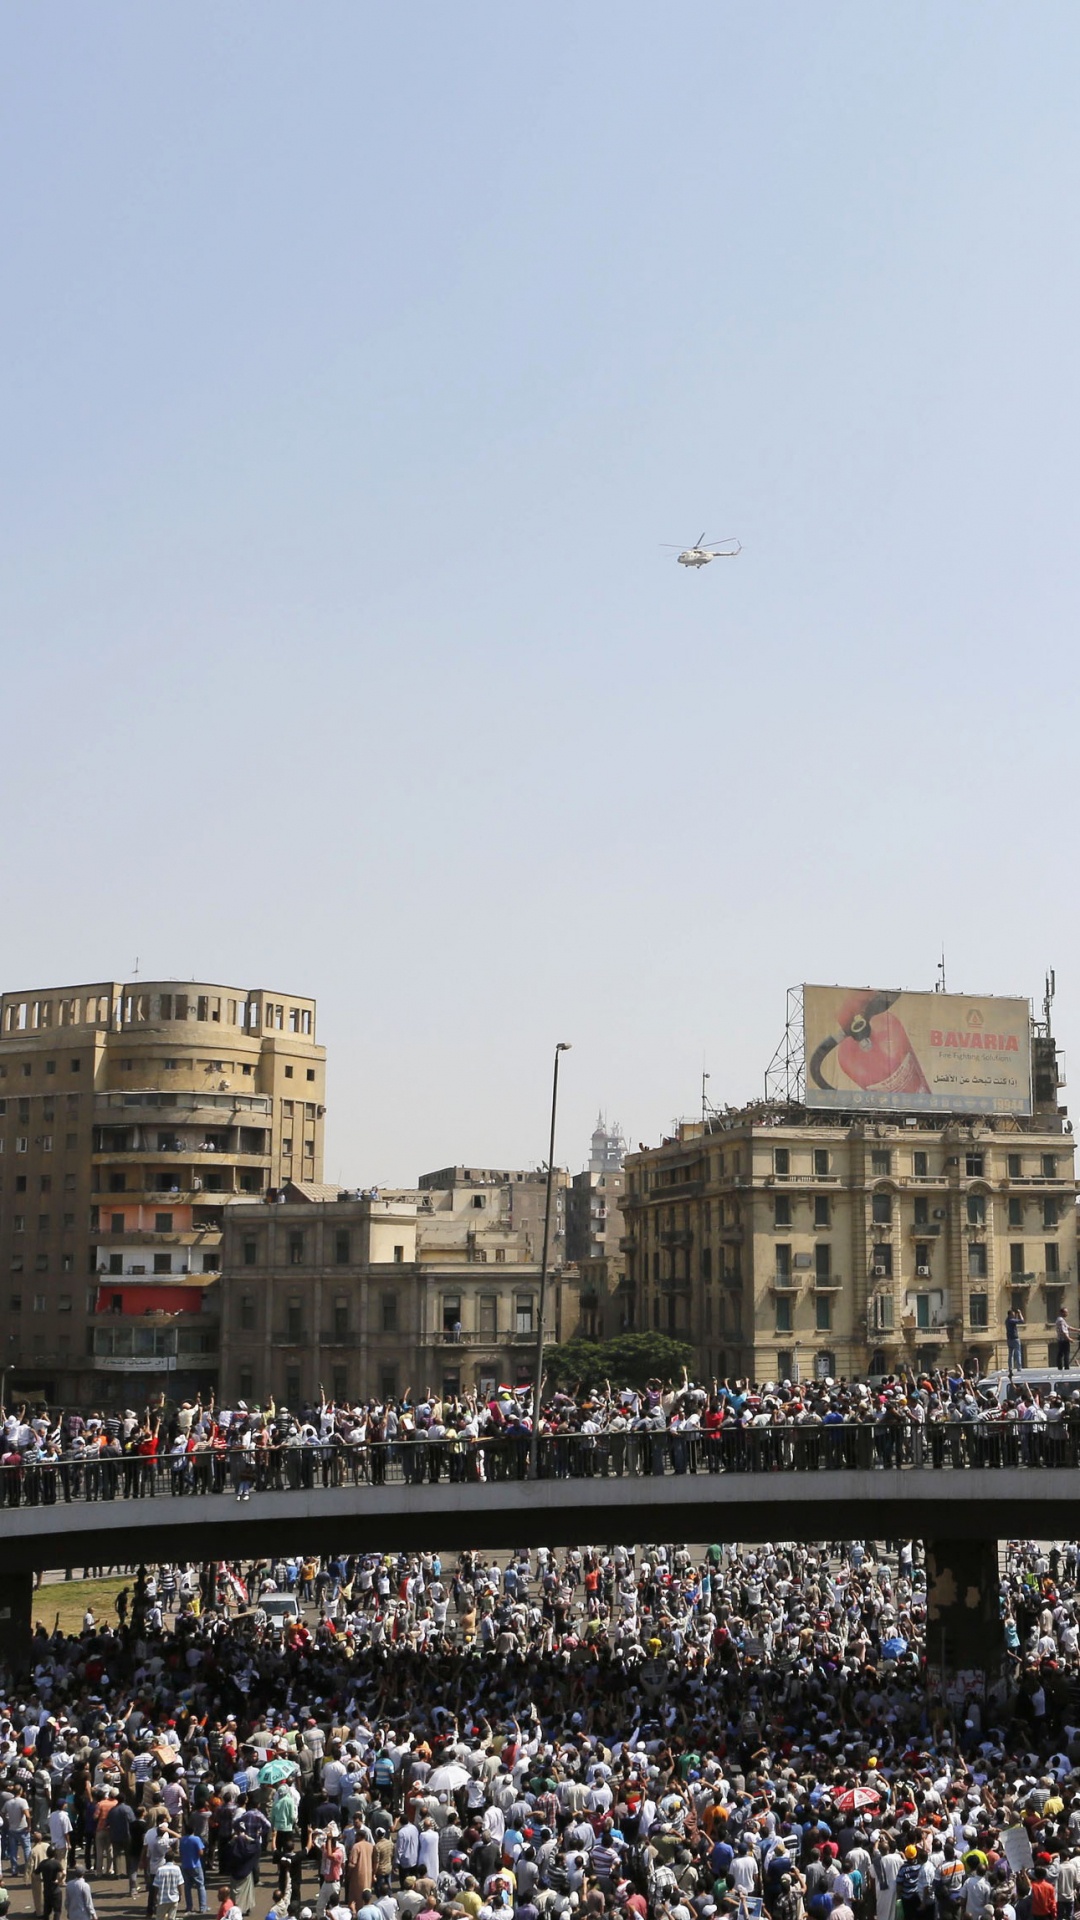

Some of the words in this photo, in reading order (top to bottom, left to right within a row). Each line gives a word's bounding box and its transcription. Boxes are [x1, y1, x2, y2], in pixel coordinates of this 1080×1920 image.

[930, 1030, 1019, 1052] BAVARIA
[953, 1052, 980, 1062] Fighting
[981, 1054, 1011, 1062] Solutions
[959, 1076, 970, 1085] عن
